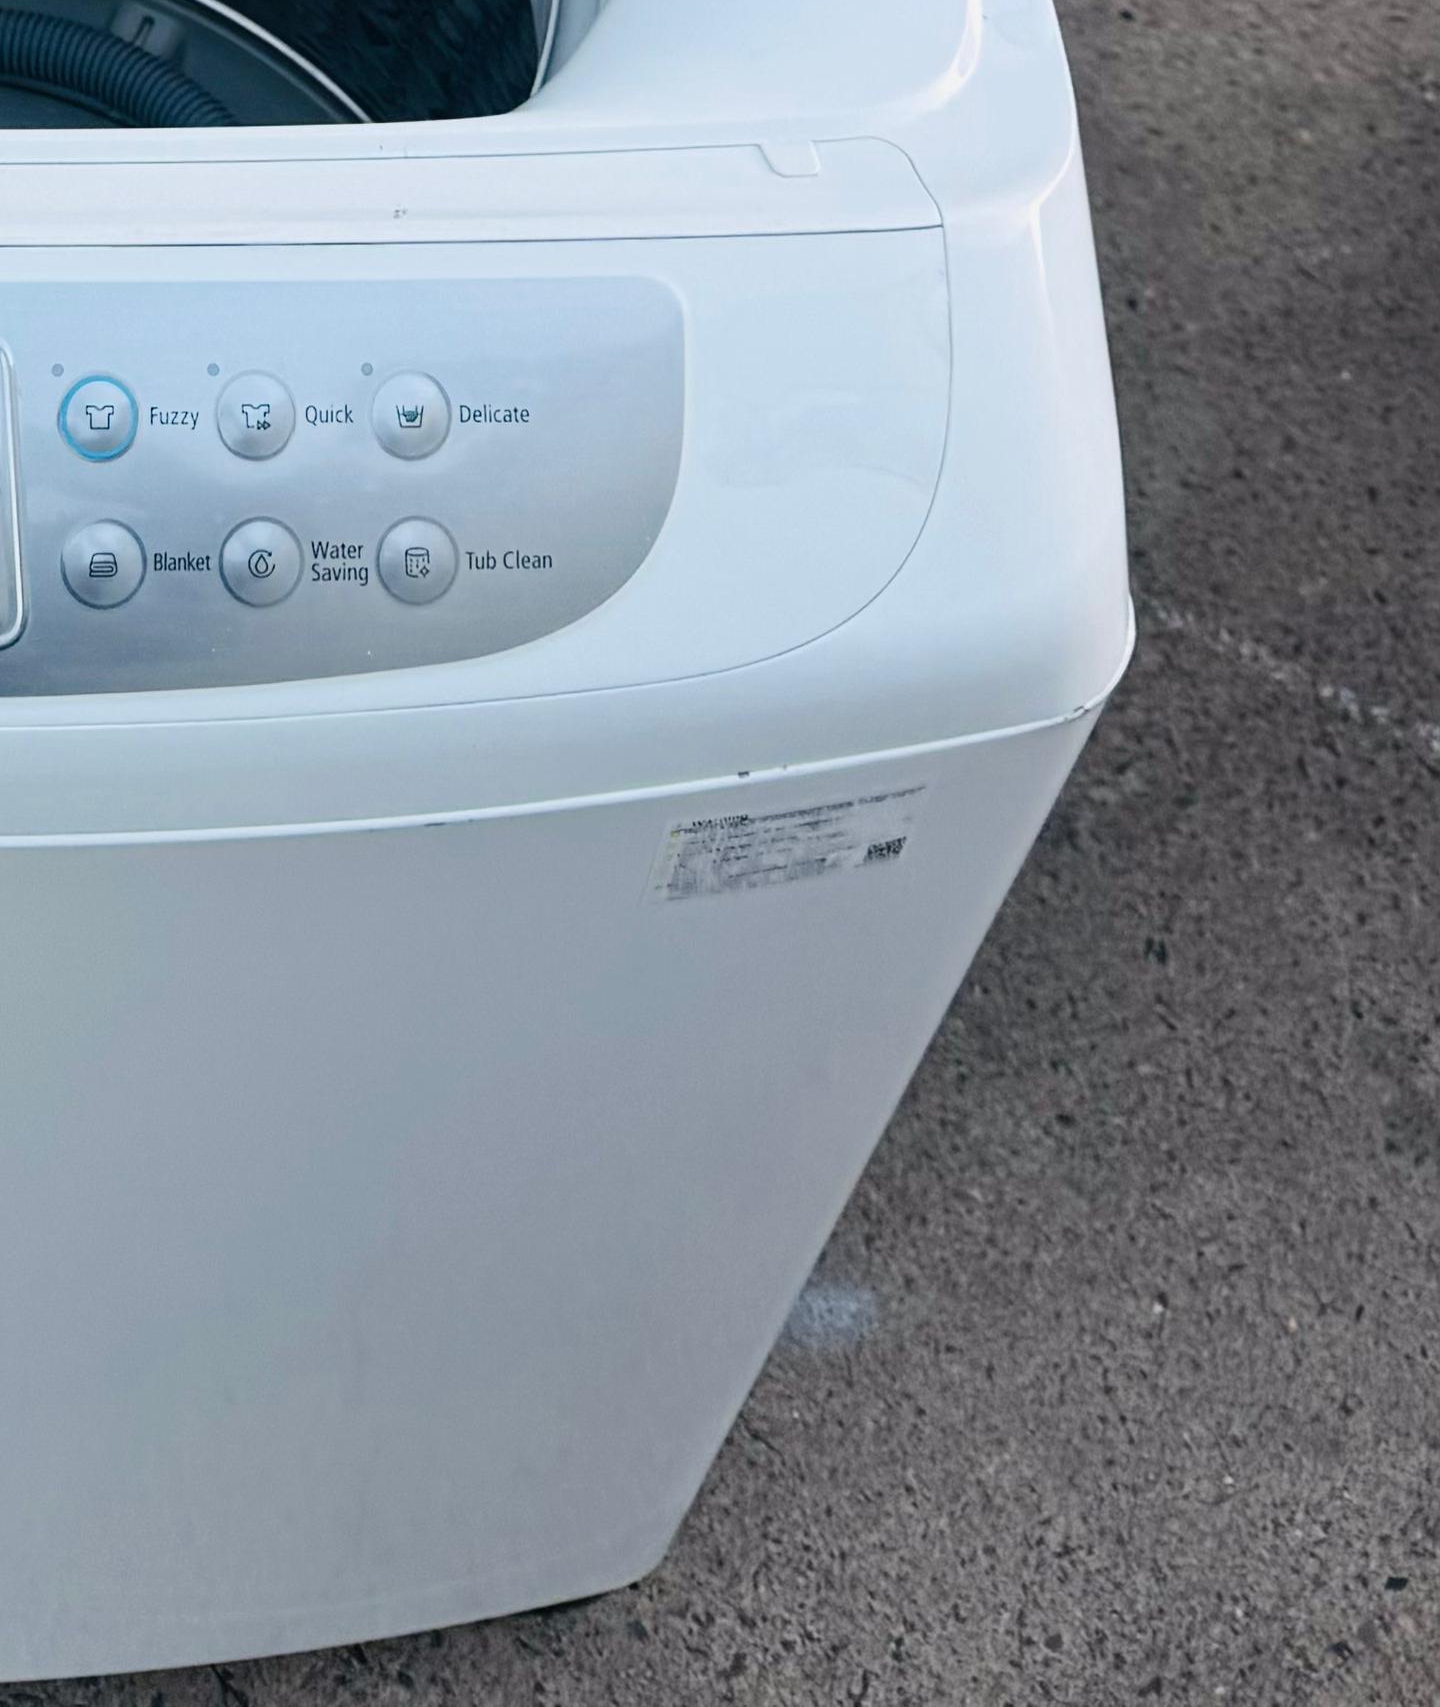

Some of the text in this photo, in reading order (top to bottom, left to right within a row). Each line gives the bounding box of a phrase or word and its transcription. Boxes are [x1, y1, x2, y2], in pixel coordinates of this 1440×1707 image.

[150, 407, 200, 430] Fuzzy
[305, 405, 355, 426] Quick
[459, 405, 531, 424] Delicate
[311, 541, 364, 560] Water
[465, 550, 553, 570] Tub Clean
[153, 553, 212, 572] Blanket
[311, 563, 369, 586] Saving
